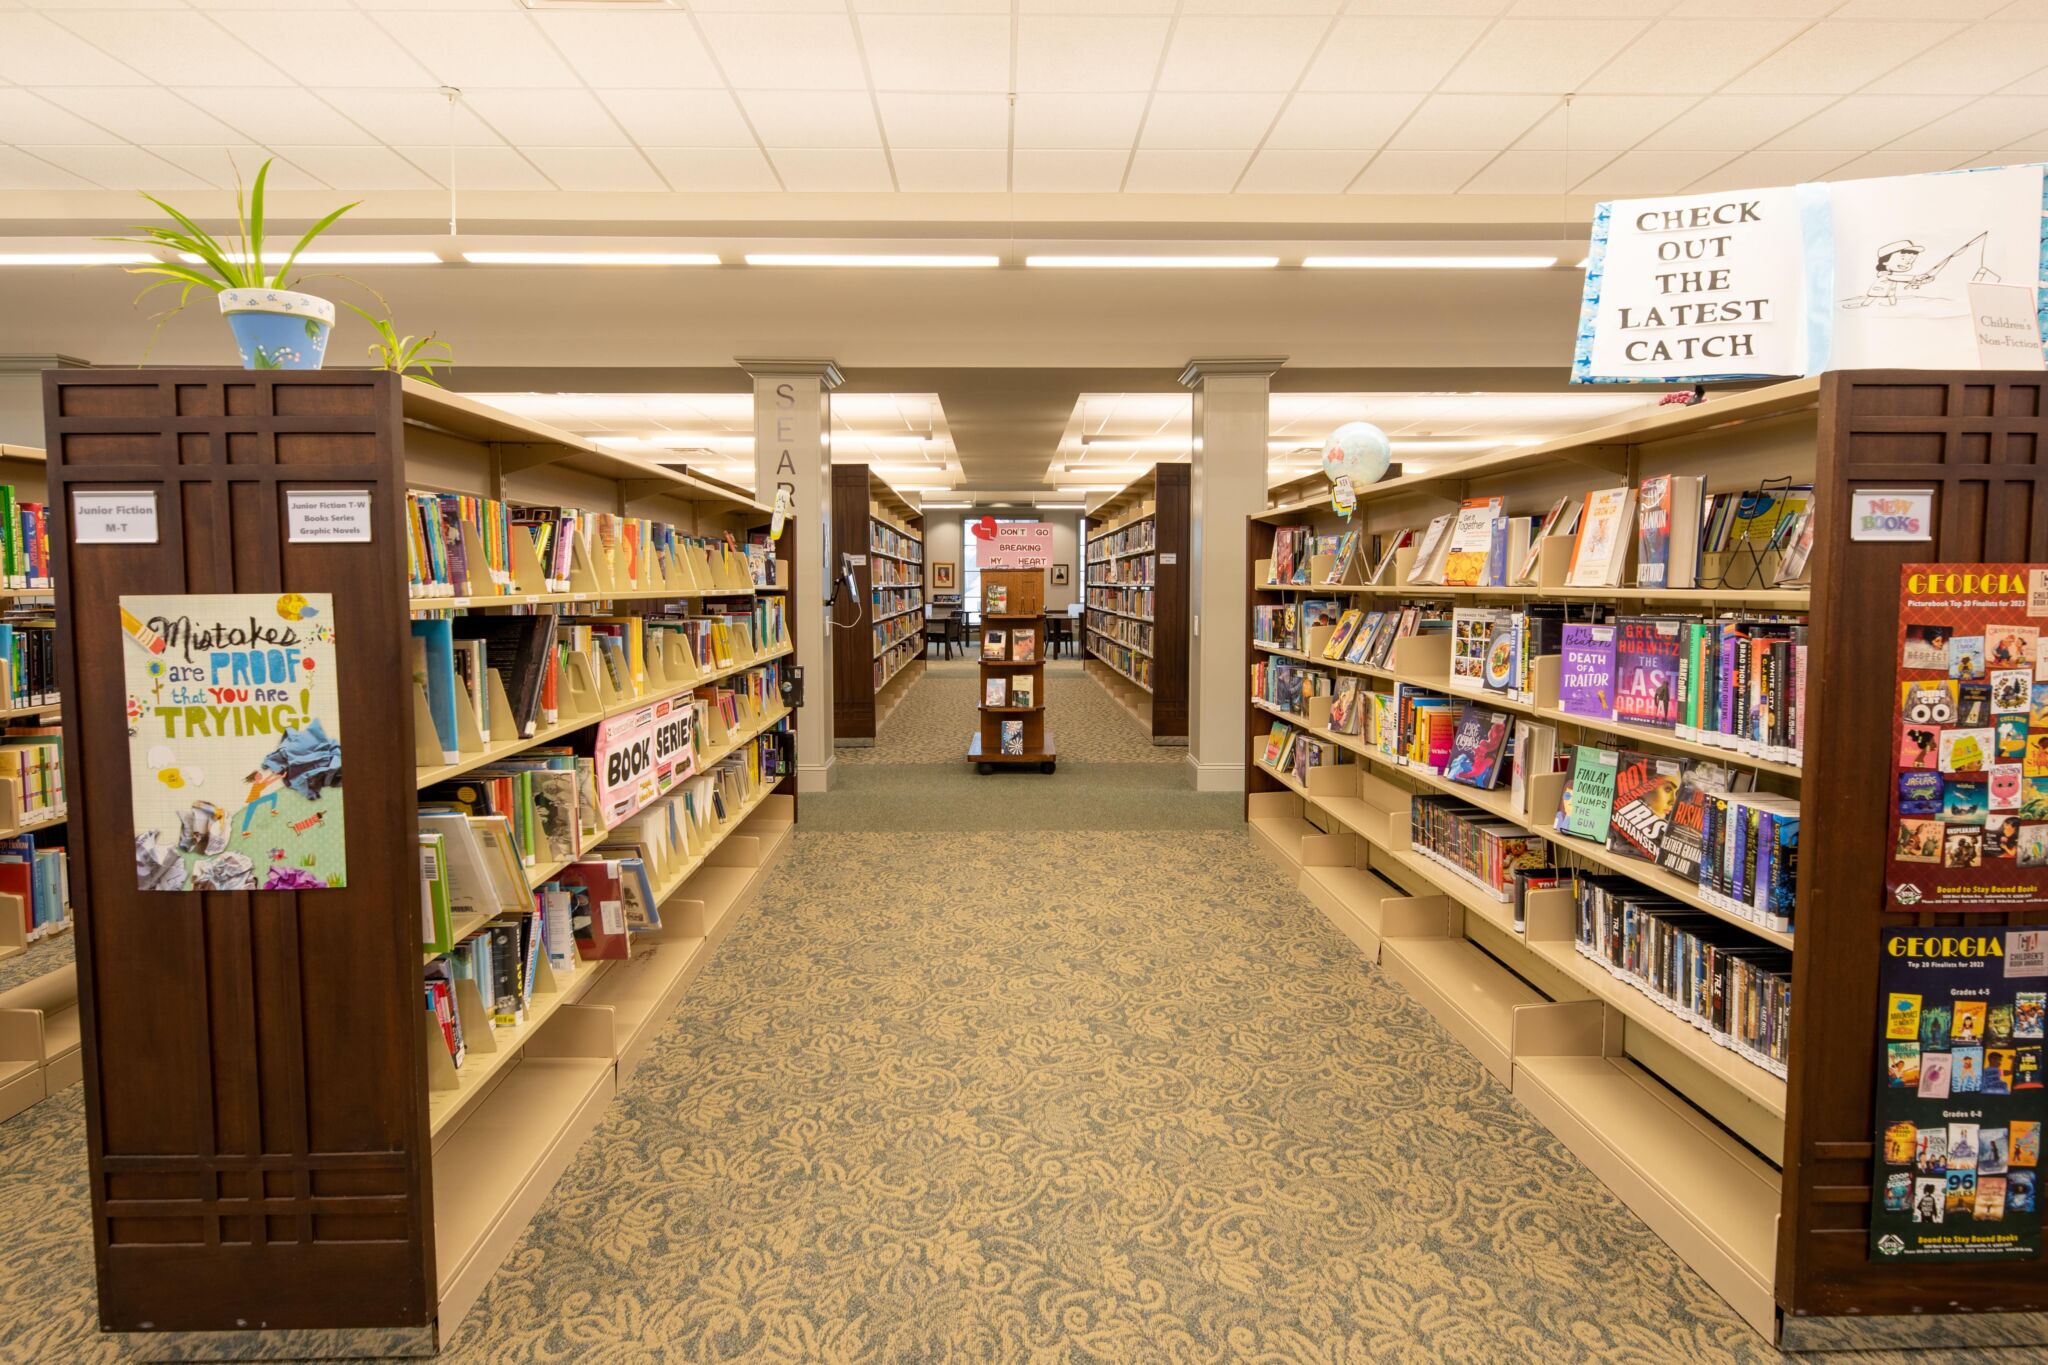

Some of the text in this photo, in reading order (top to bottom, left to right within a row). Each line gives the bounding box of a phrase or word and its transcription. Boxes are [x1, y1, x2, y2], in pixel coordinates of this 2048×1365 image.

[1636, 201, 1761, 232] CHECK
[1658, 236, 1732, 261] OUT
[1655, 270, 1731, 294] THE
[1618, 299, 1769, 330] LATEST
[1981, 315, 2032, 330] Children's
[1624, 334, 1754, 362] CATCH
[1978, 333, 2038, 349] Non-Fiction
[78, 505, 153, 516] Junior Fiction
[292, 501, 366, 510] Junior Fiction T-W
[1869, 498, 1914, 515] NEW
[304, 514, 354, 522] Books Series
[1458, 520, 1485, 532] Together
[1861, 515, 1920, 534] BOOKS
[105, 523, 128, 533] M-T
[300, 526, 360, 536] Graphic Novels
[1001, 528, 1025, 536] DON'T
[1000, 544, 1041, 552] BREAKING
[990, 557, 1047, 565] MY HEART
[1908, 573, 2026, 595] GEORGIA
[1950, 600, 1961, 608] Top
[147, 615, 302, 663] Mistakes
[1619, 639, 1680, 656] HURWITZ
[1569, 652, 1606, 664] DEATH
[1639, 656, 1658, 667] THE
[169, 648, 301, 686] are PROOF
[1564, 673, 1609, 687] TRAITOR
[1617, 667, 1679, 697] LAST
[171, 687, 248, 705] that YOU
[154, 688, 312, 739] TRYING!
[1616, 695, 1678, 720] ORPHAN
[608, 737, 650, 788] BOOK
[1576, 768, 1610, 784] FINLAY
[1617, 758, 1648, 796] ROY
[1577, 782, 1613, 799] DONOVAN
[1575, 806, 1591, 817] THE
[1577, 797, 1607, 809] JUMPS
[1577, 817, 1595, 829] GUN
[1618, 799, 1668, 839] IRIS
[1674, 801, 1704, 831] RISIN
[1612, 811, 1660, 858] JOHANSEN
[1664, 853, 1691, 875] JON LAND
[1725, 846, 1733, 876] PENNY
[1771, 857, 1779, 887] PENNY
[1973, 886, 1990, 895] Stay
[1991, 885, 2016, 893] Bound
[2018, 885, 2038, 893] Books
[1887, 936, 2004, 957] GEORGIA
[1907, 961, 1920, 969] Top
[1950, 988, 1977, 996] Grades
[1942, 1110, 1983, 1118] Grades 6-8
[1948, 1174, 1974, 1191] 96
[1918, 1236, 1942, 1244] Bound
[1953, 1235, 1970, 1245] Stay
[1971, 1235, 1996, 1243] Bound
[1997, 1234, 2018, 1242] Books
